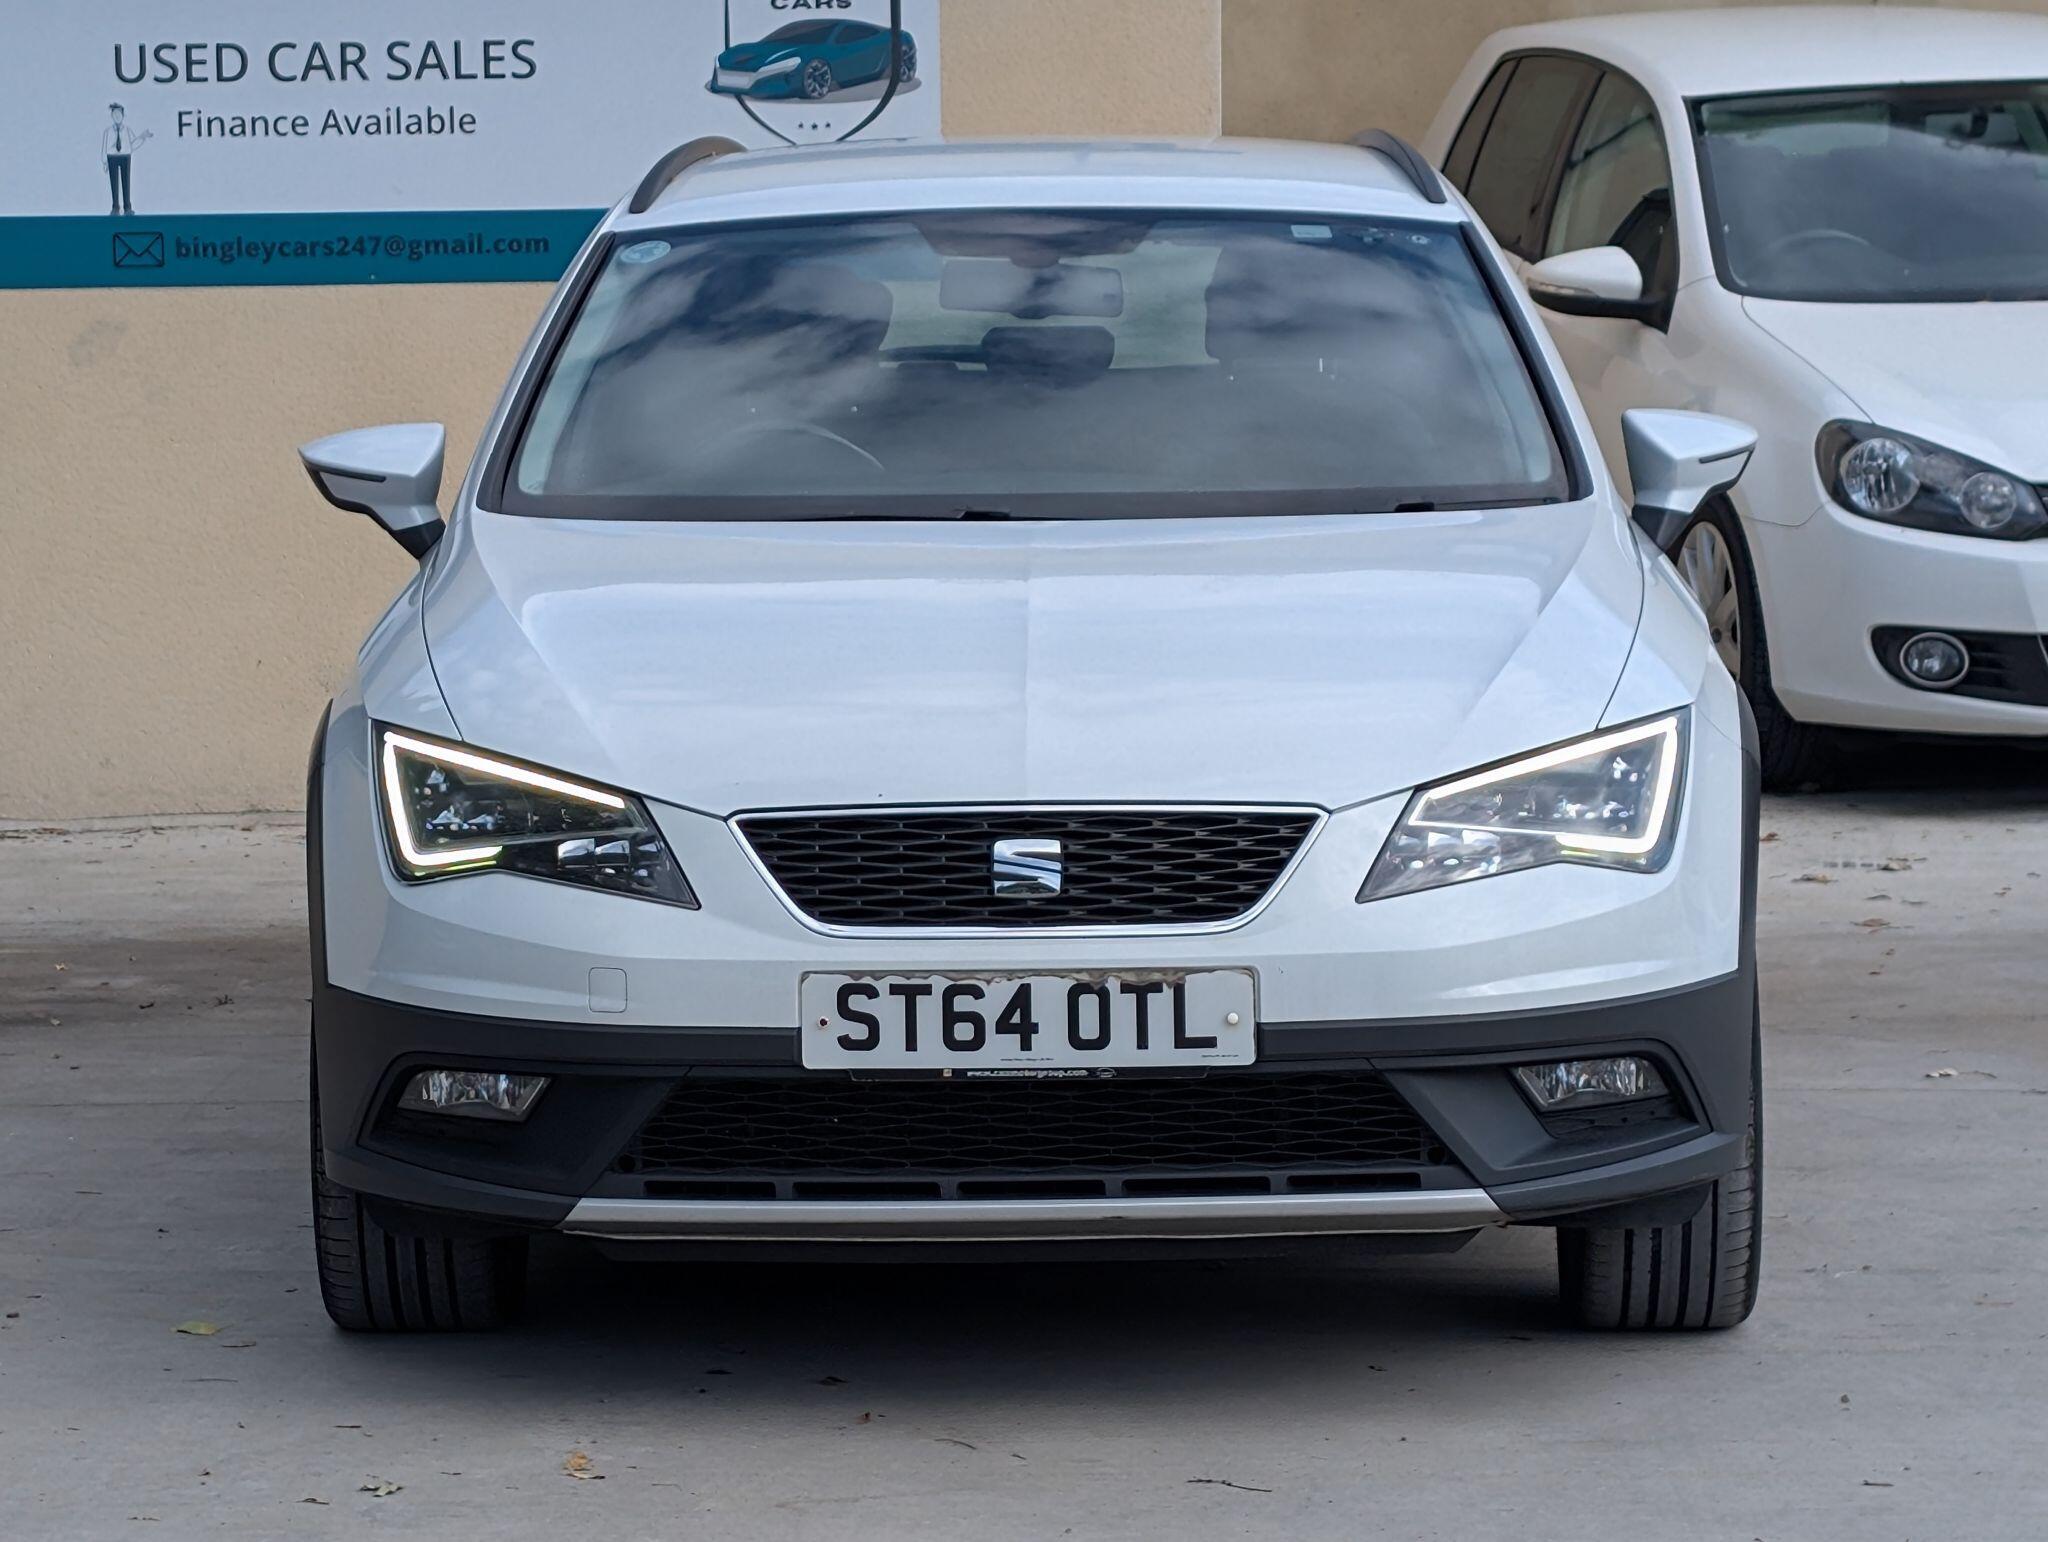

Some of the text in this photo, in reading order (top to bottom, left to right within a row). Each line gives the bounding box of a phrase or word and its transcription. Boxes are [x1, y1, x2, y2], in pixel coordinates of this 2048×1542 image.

[114, 38, 538, 84] USED CAR SALES
[177, 105, 477, 138] Finance Available
[174, 234, 550, 265] bingleycars247@gmail.com
[836, 982, 1218, 1052] ST64 OTL
